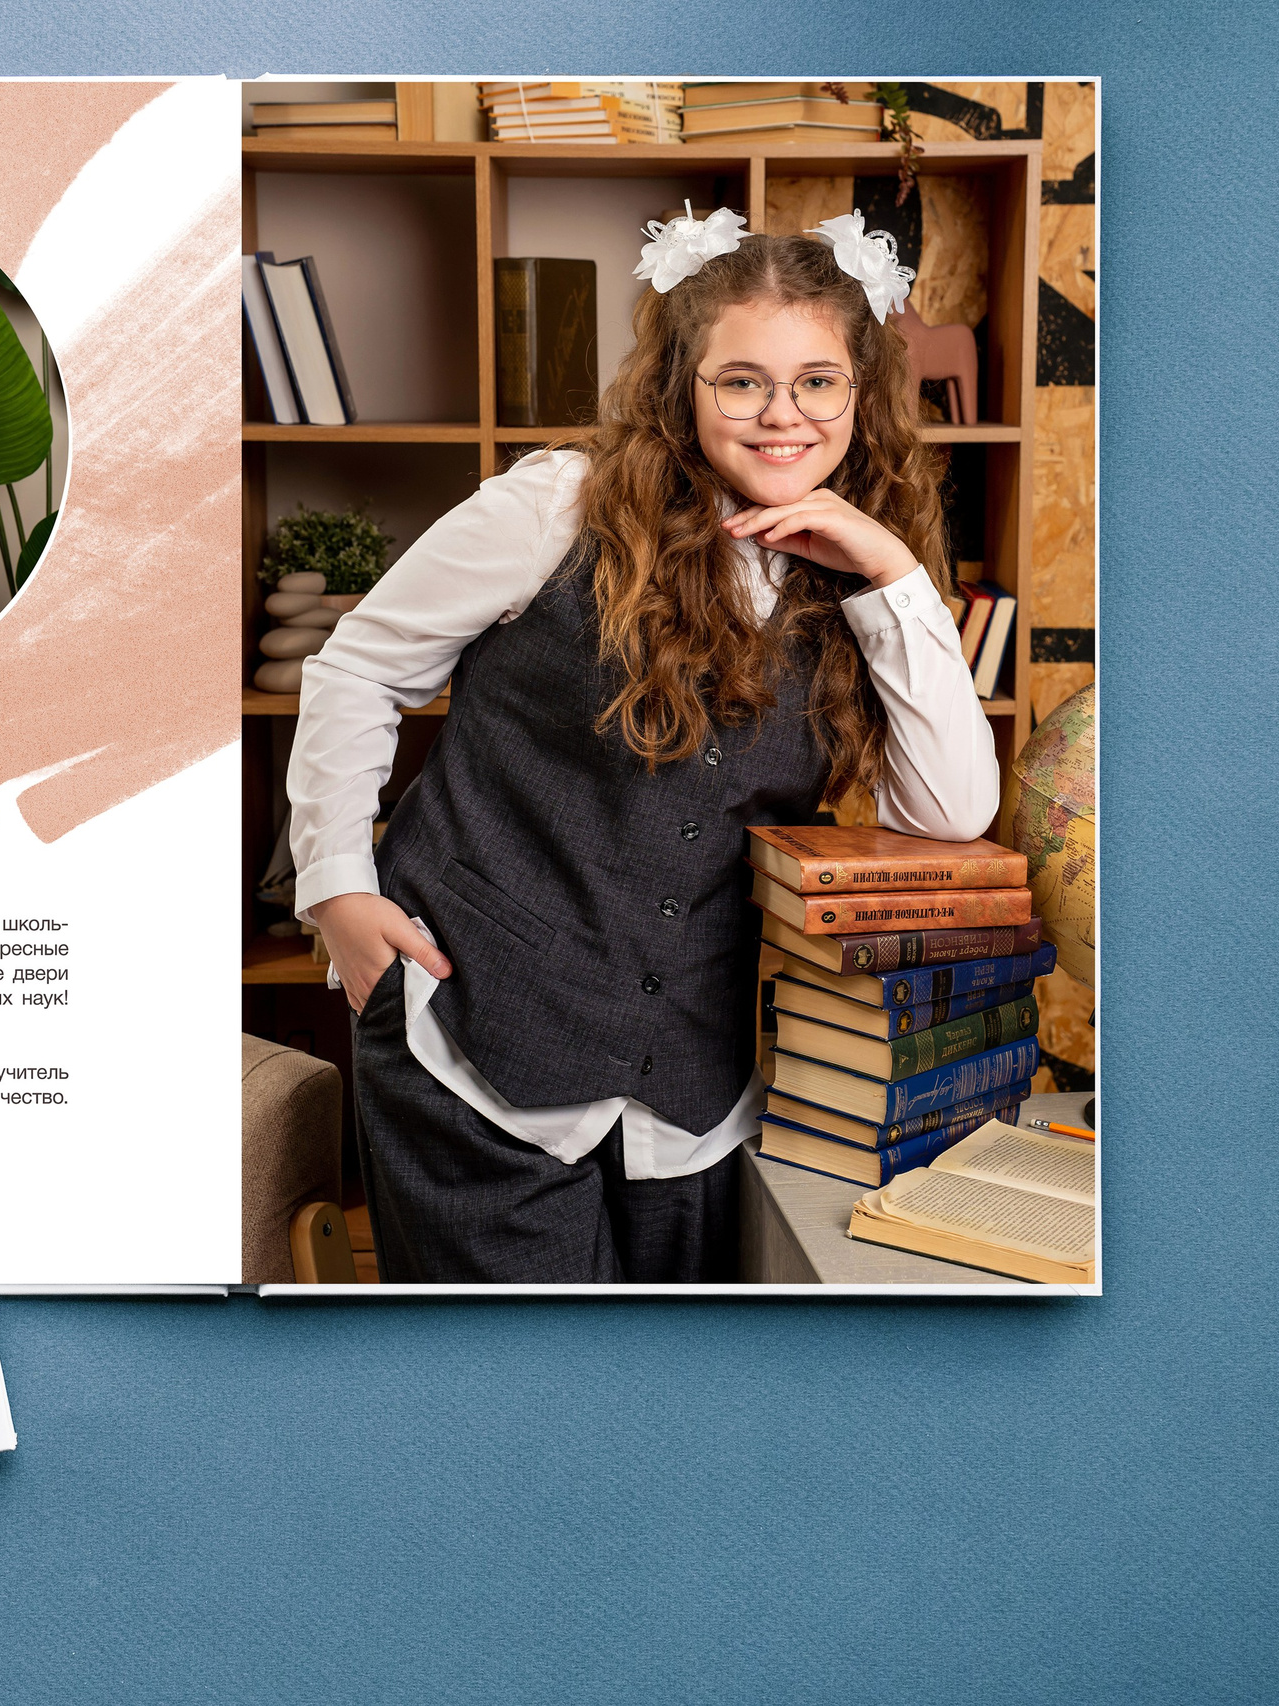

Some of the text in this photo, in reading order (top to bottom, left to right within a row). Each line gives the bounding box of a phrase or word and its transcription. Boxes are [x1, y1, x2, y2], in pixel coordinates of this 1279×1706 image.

[3, 919, 69, 932] школь-
[929, 933, 990, 949] СТИВЕНСОН
[957, 945, 988, 957] Роберт
[12, 968, 68, 985] двери
[974, 963, 995, 976] ВЕРН
[22, 989, 68, 1010] наук!
[945, 1026, 972, 1041] Чарльз
[941, 1036, 978, 1058] ДИККЕНС
[954, 1096, 984, 1114] ГОГОЛЬ
